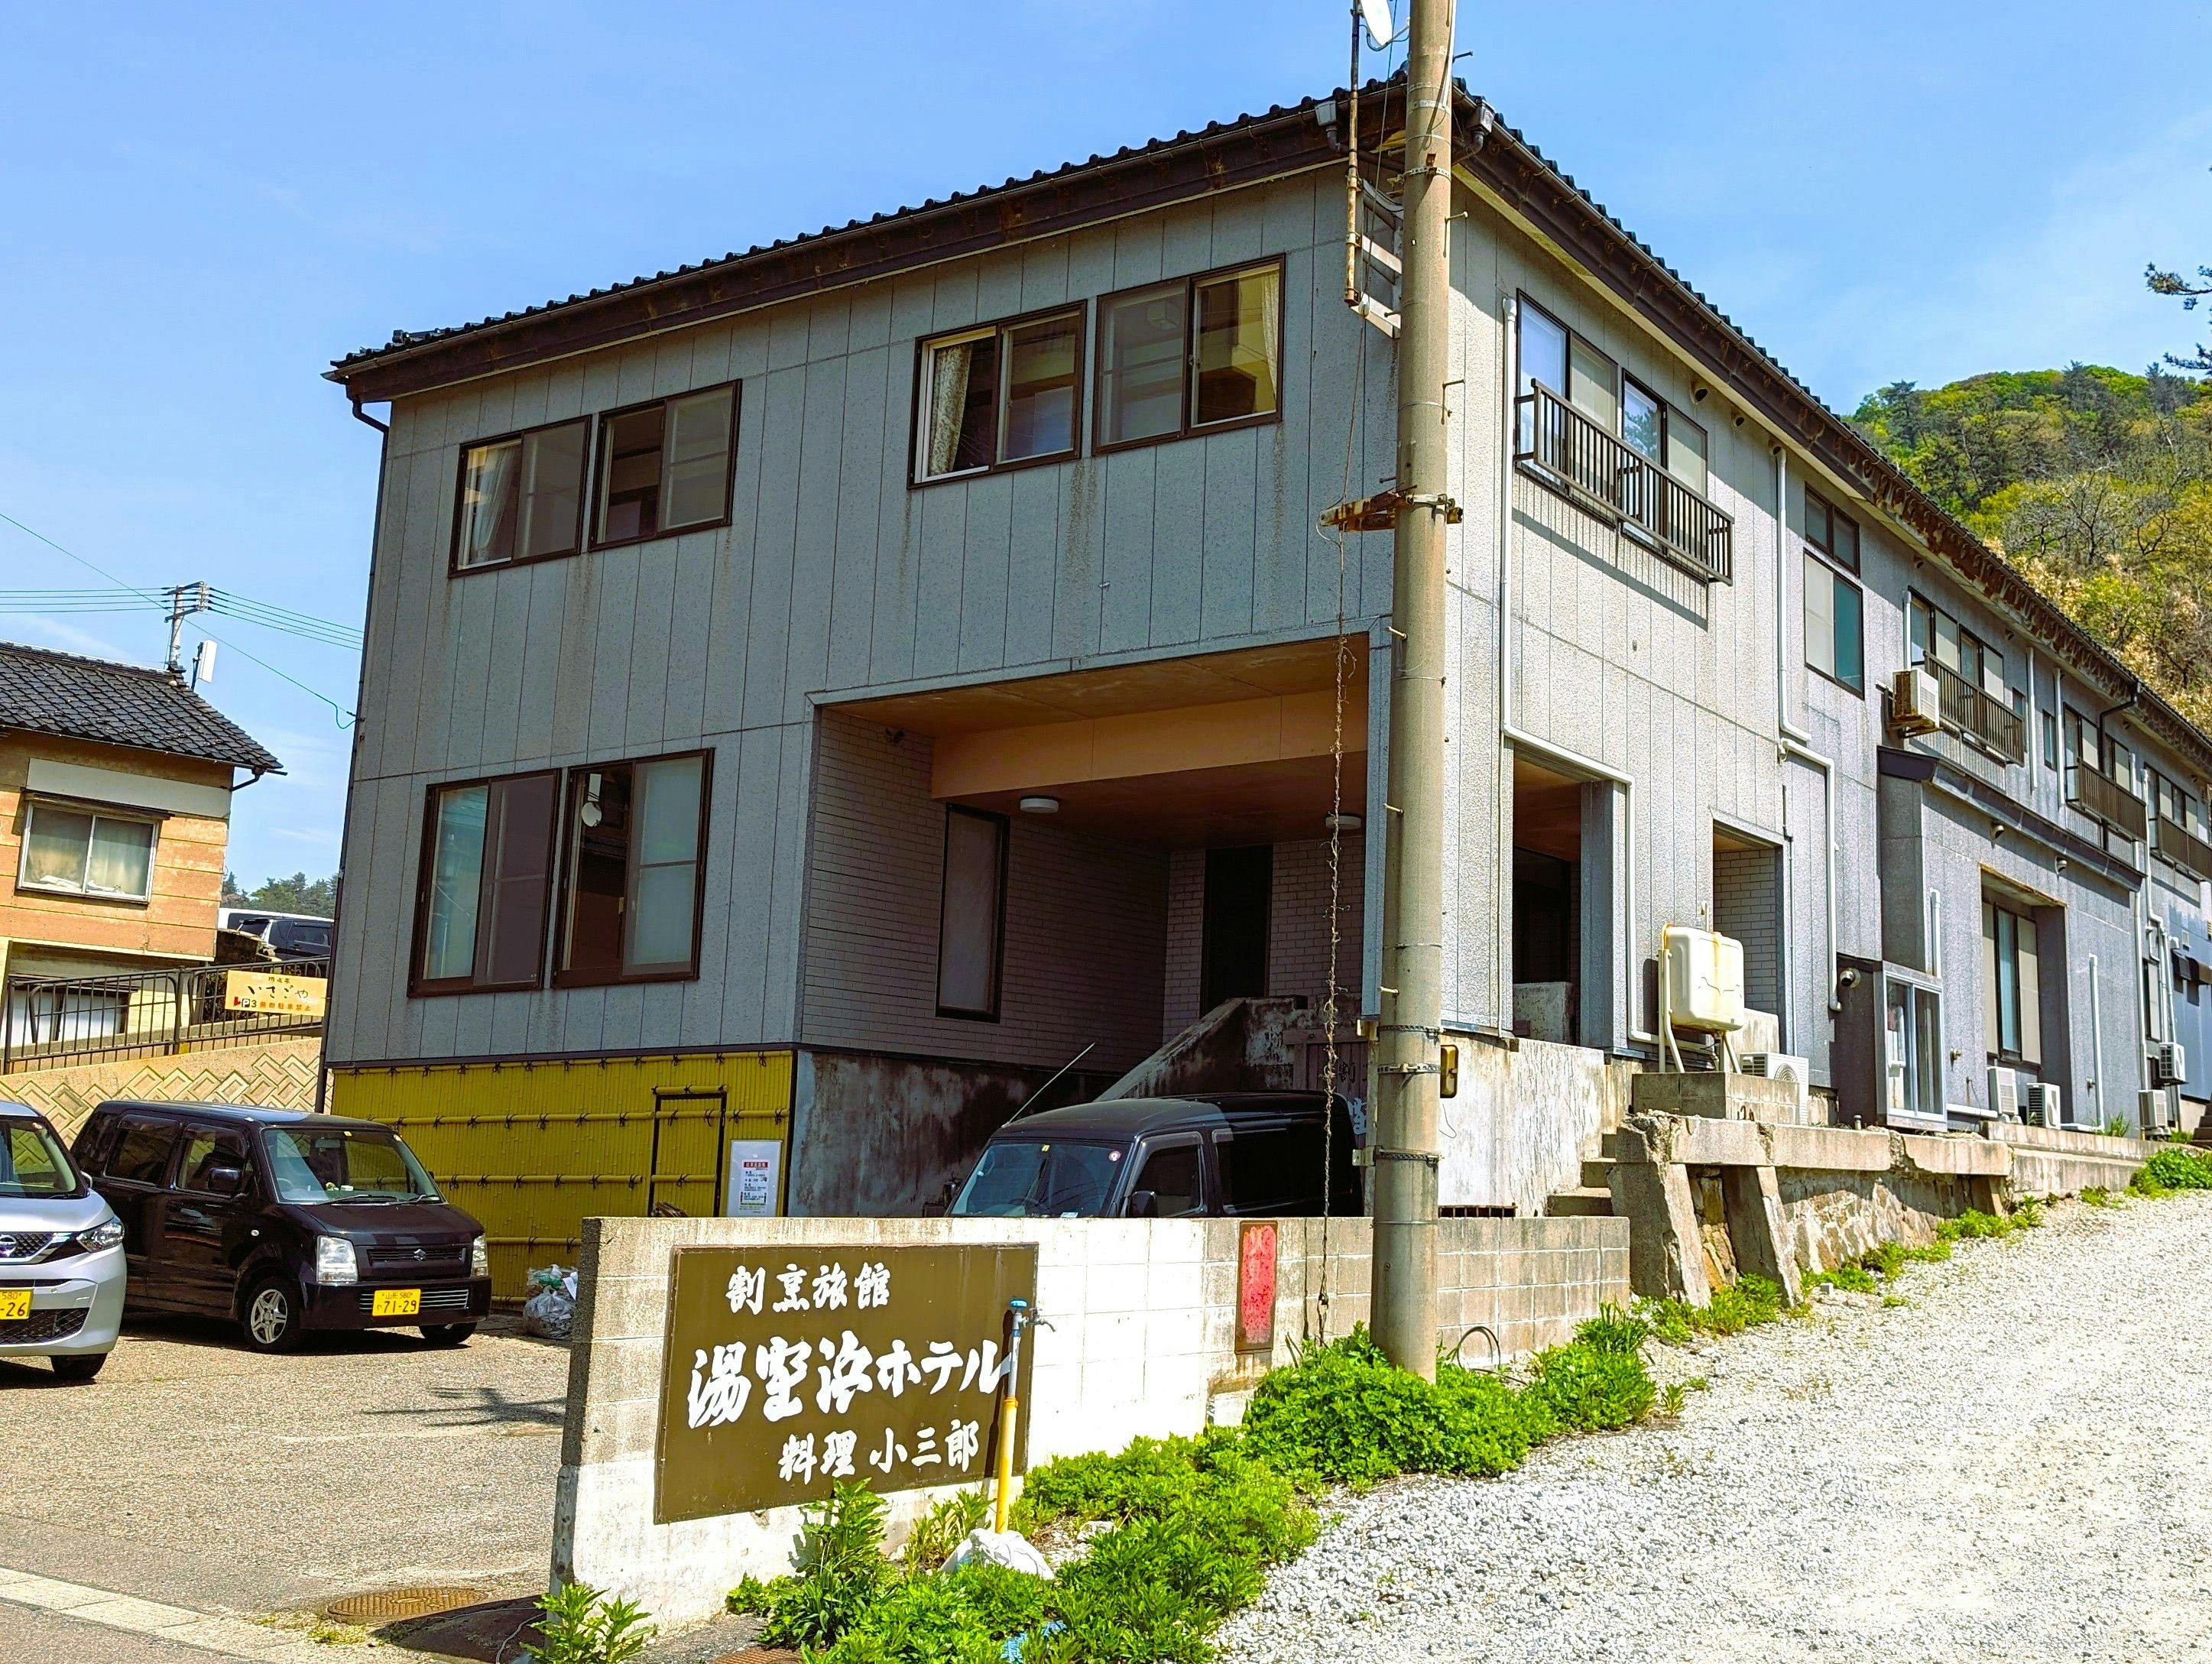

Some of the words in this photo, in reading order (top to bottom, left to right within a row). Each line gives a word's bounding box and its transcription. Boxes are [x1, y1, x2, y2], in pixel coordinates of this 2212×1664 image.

[247, 984, 309, 999] いさごや
[725, 1262, 890, 1315] 割烹旅館
[384, 1300, 417, 1313] 71-29
[778, 1430, 857, 1484] 料理
[870, 1419, 979, 1474] 小三郎
